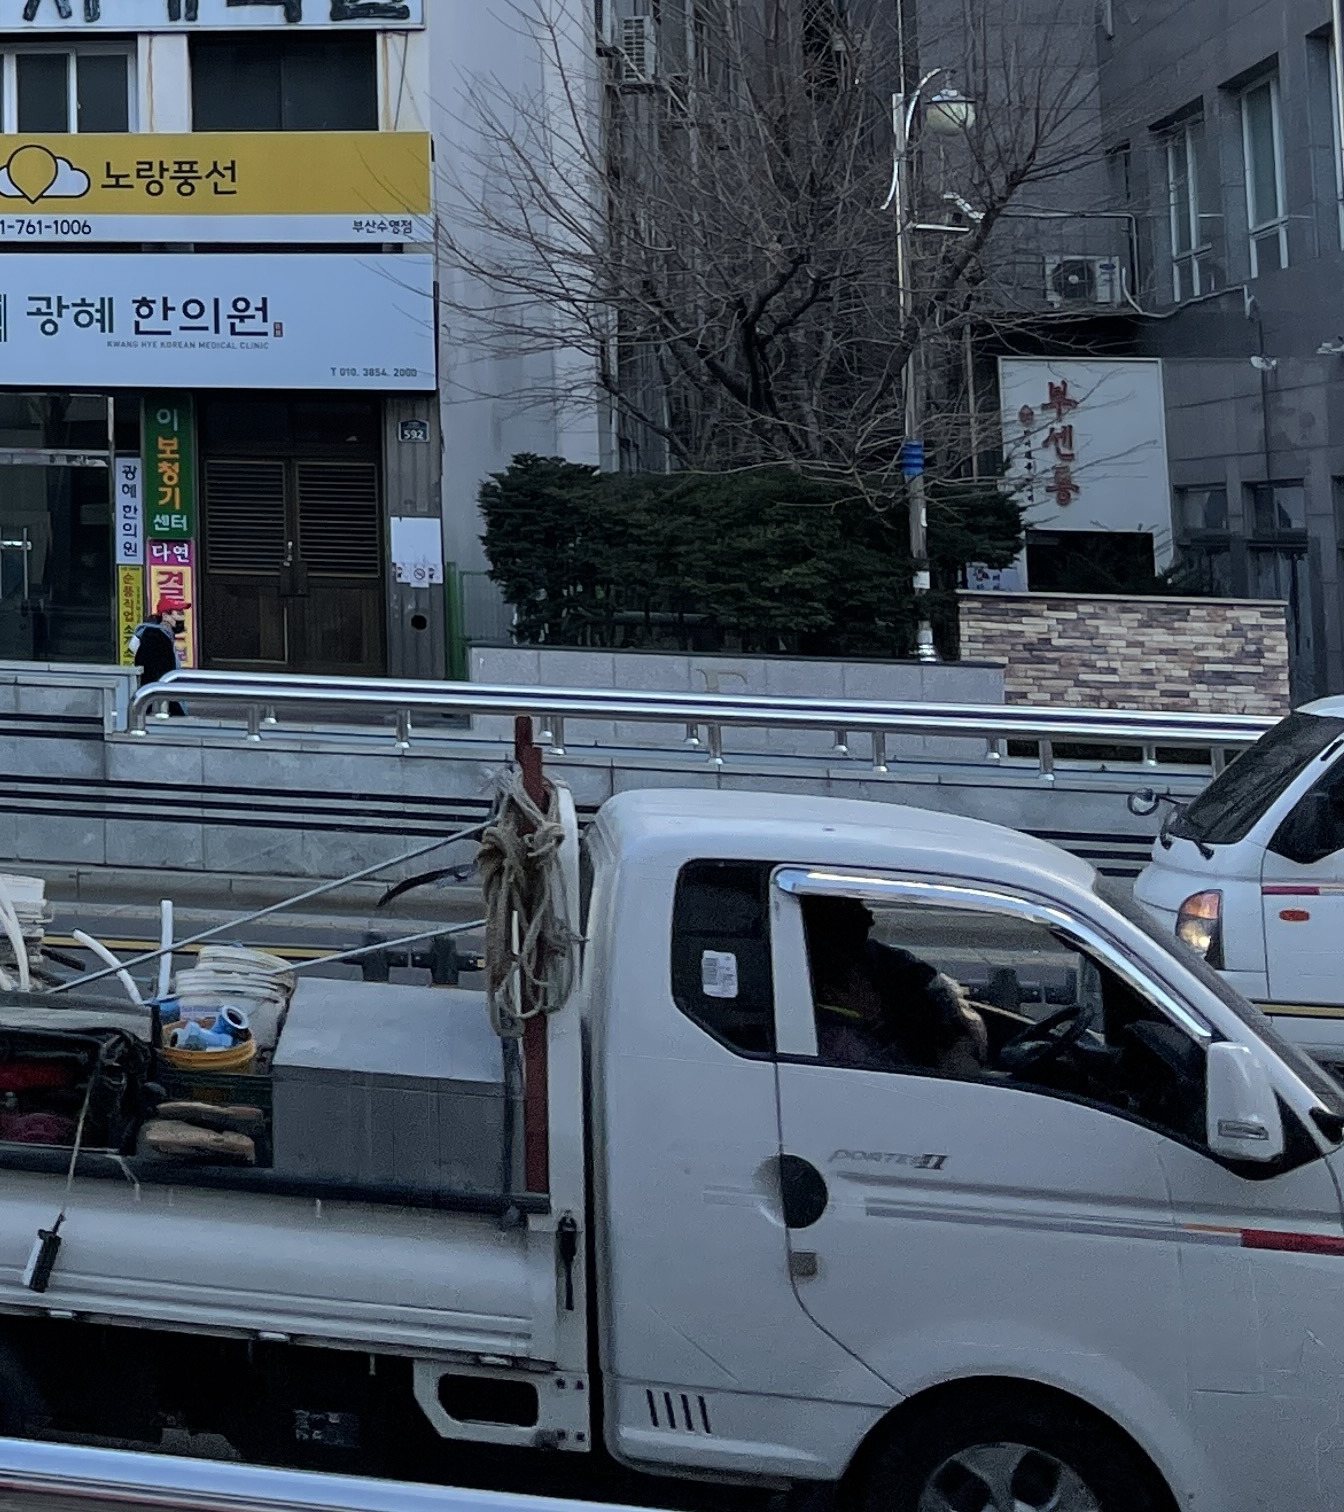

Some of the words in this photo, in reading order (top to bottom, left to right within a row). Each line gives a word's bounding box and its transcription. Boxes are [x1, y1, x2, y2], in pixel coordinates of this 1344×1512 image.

[100, 159, 239, 197] 노랑풍선
[351, 217, 413, 235] 부산수영점
[25, 295, 114, 337] 광혜
[131, 295, 269, 337] 한의원
[198, 341, 237, 350] MEDICAL
[239, 341, 270, 350] CLINIC
[155, 408, 179, 432] 이
[403, 429, 425, 440] 592
[156, 436, 181, 510] 보청기
[122, 505, 139, 557] 한의원
[152, 514, 189, 532] 센터
[151, 543, 190, 563] 다연
